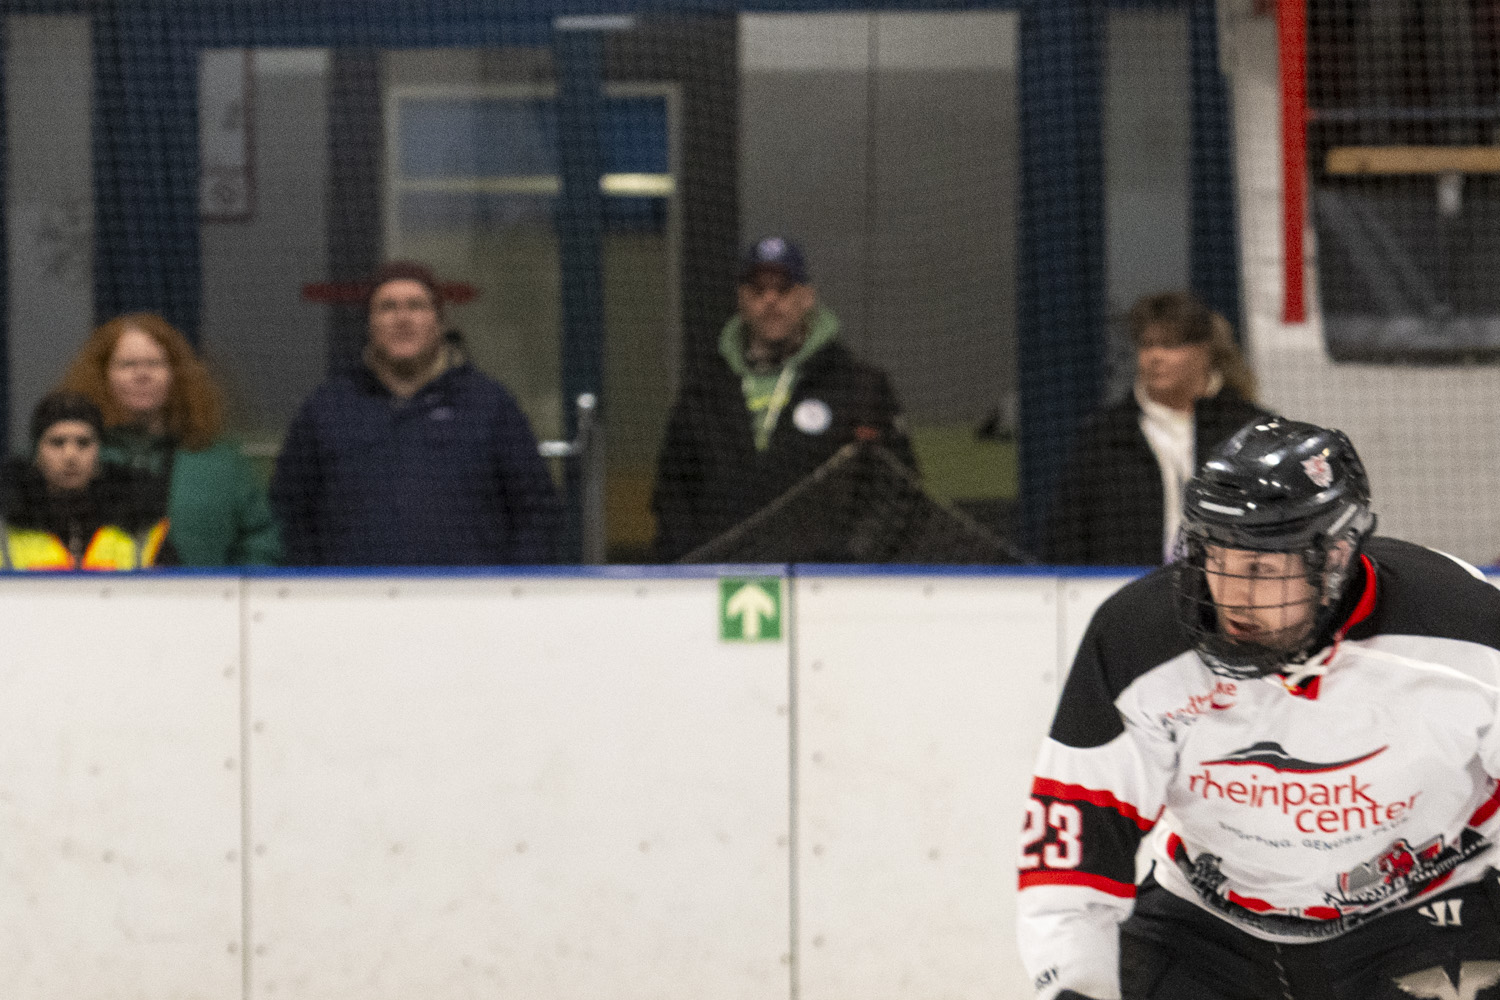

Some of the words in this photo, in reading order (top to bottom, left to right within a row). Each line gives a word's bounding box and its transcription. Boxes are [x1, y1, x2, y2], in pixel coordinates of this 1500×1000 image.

[1189, 769, 1377, 814] rheinpark
[1295, 791, 1422, 834] center
[1018, 798, 1082, 869] 23
